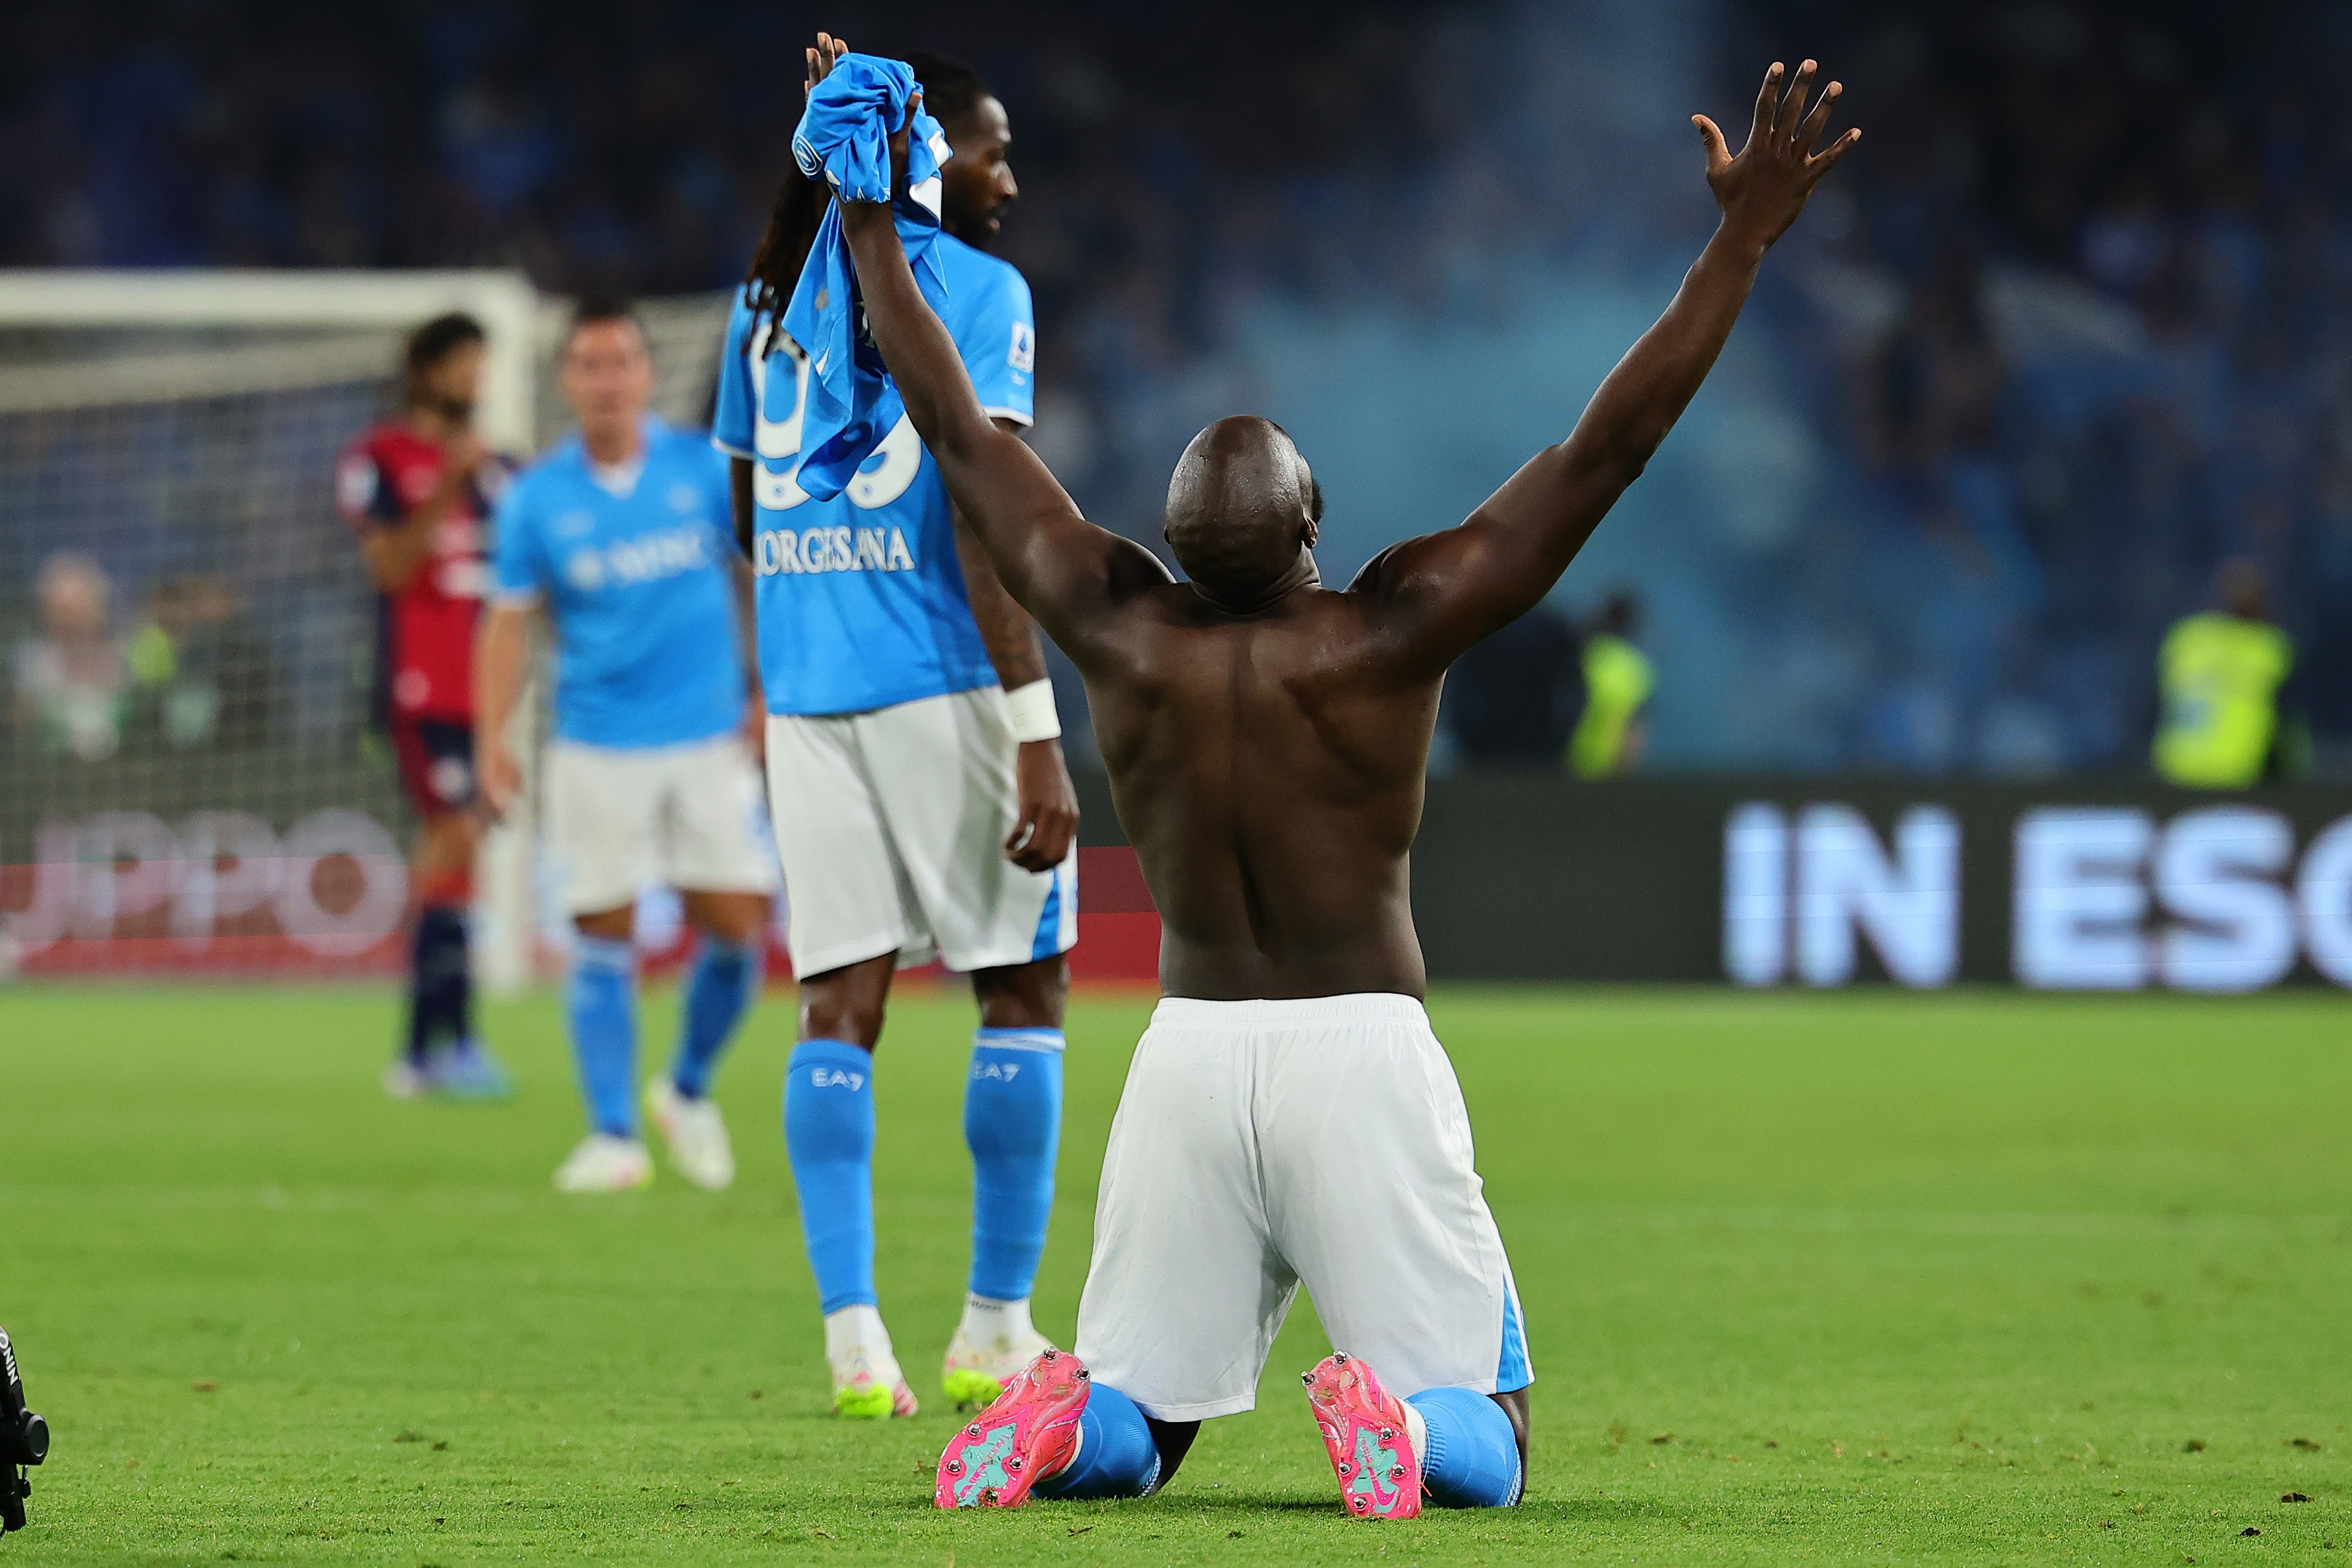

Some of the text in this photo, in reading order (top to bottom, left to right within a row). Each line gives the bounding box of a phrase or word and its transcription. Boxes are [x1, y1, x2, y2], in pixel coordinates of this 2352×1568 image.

[753, 525, 916, 576] ORGESANA
[1722, 802, 1962, 988] IN
[811, 1067, 865, 1092] EA7
[971, 1060, 1021, 1083] EA7
